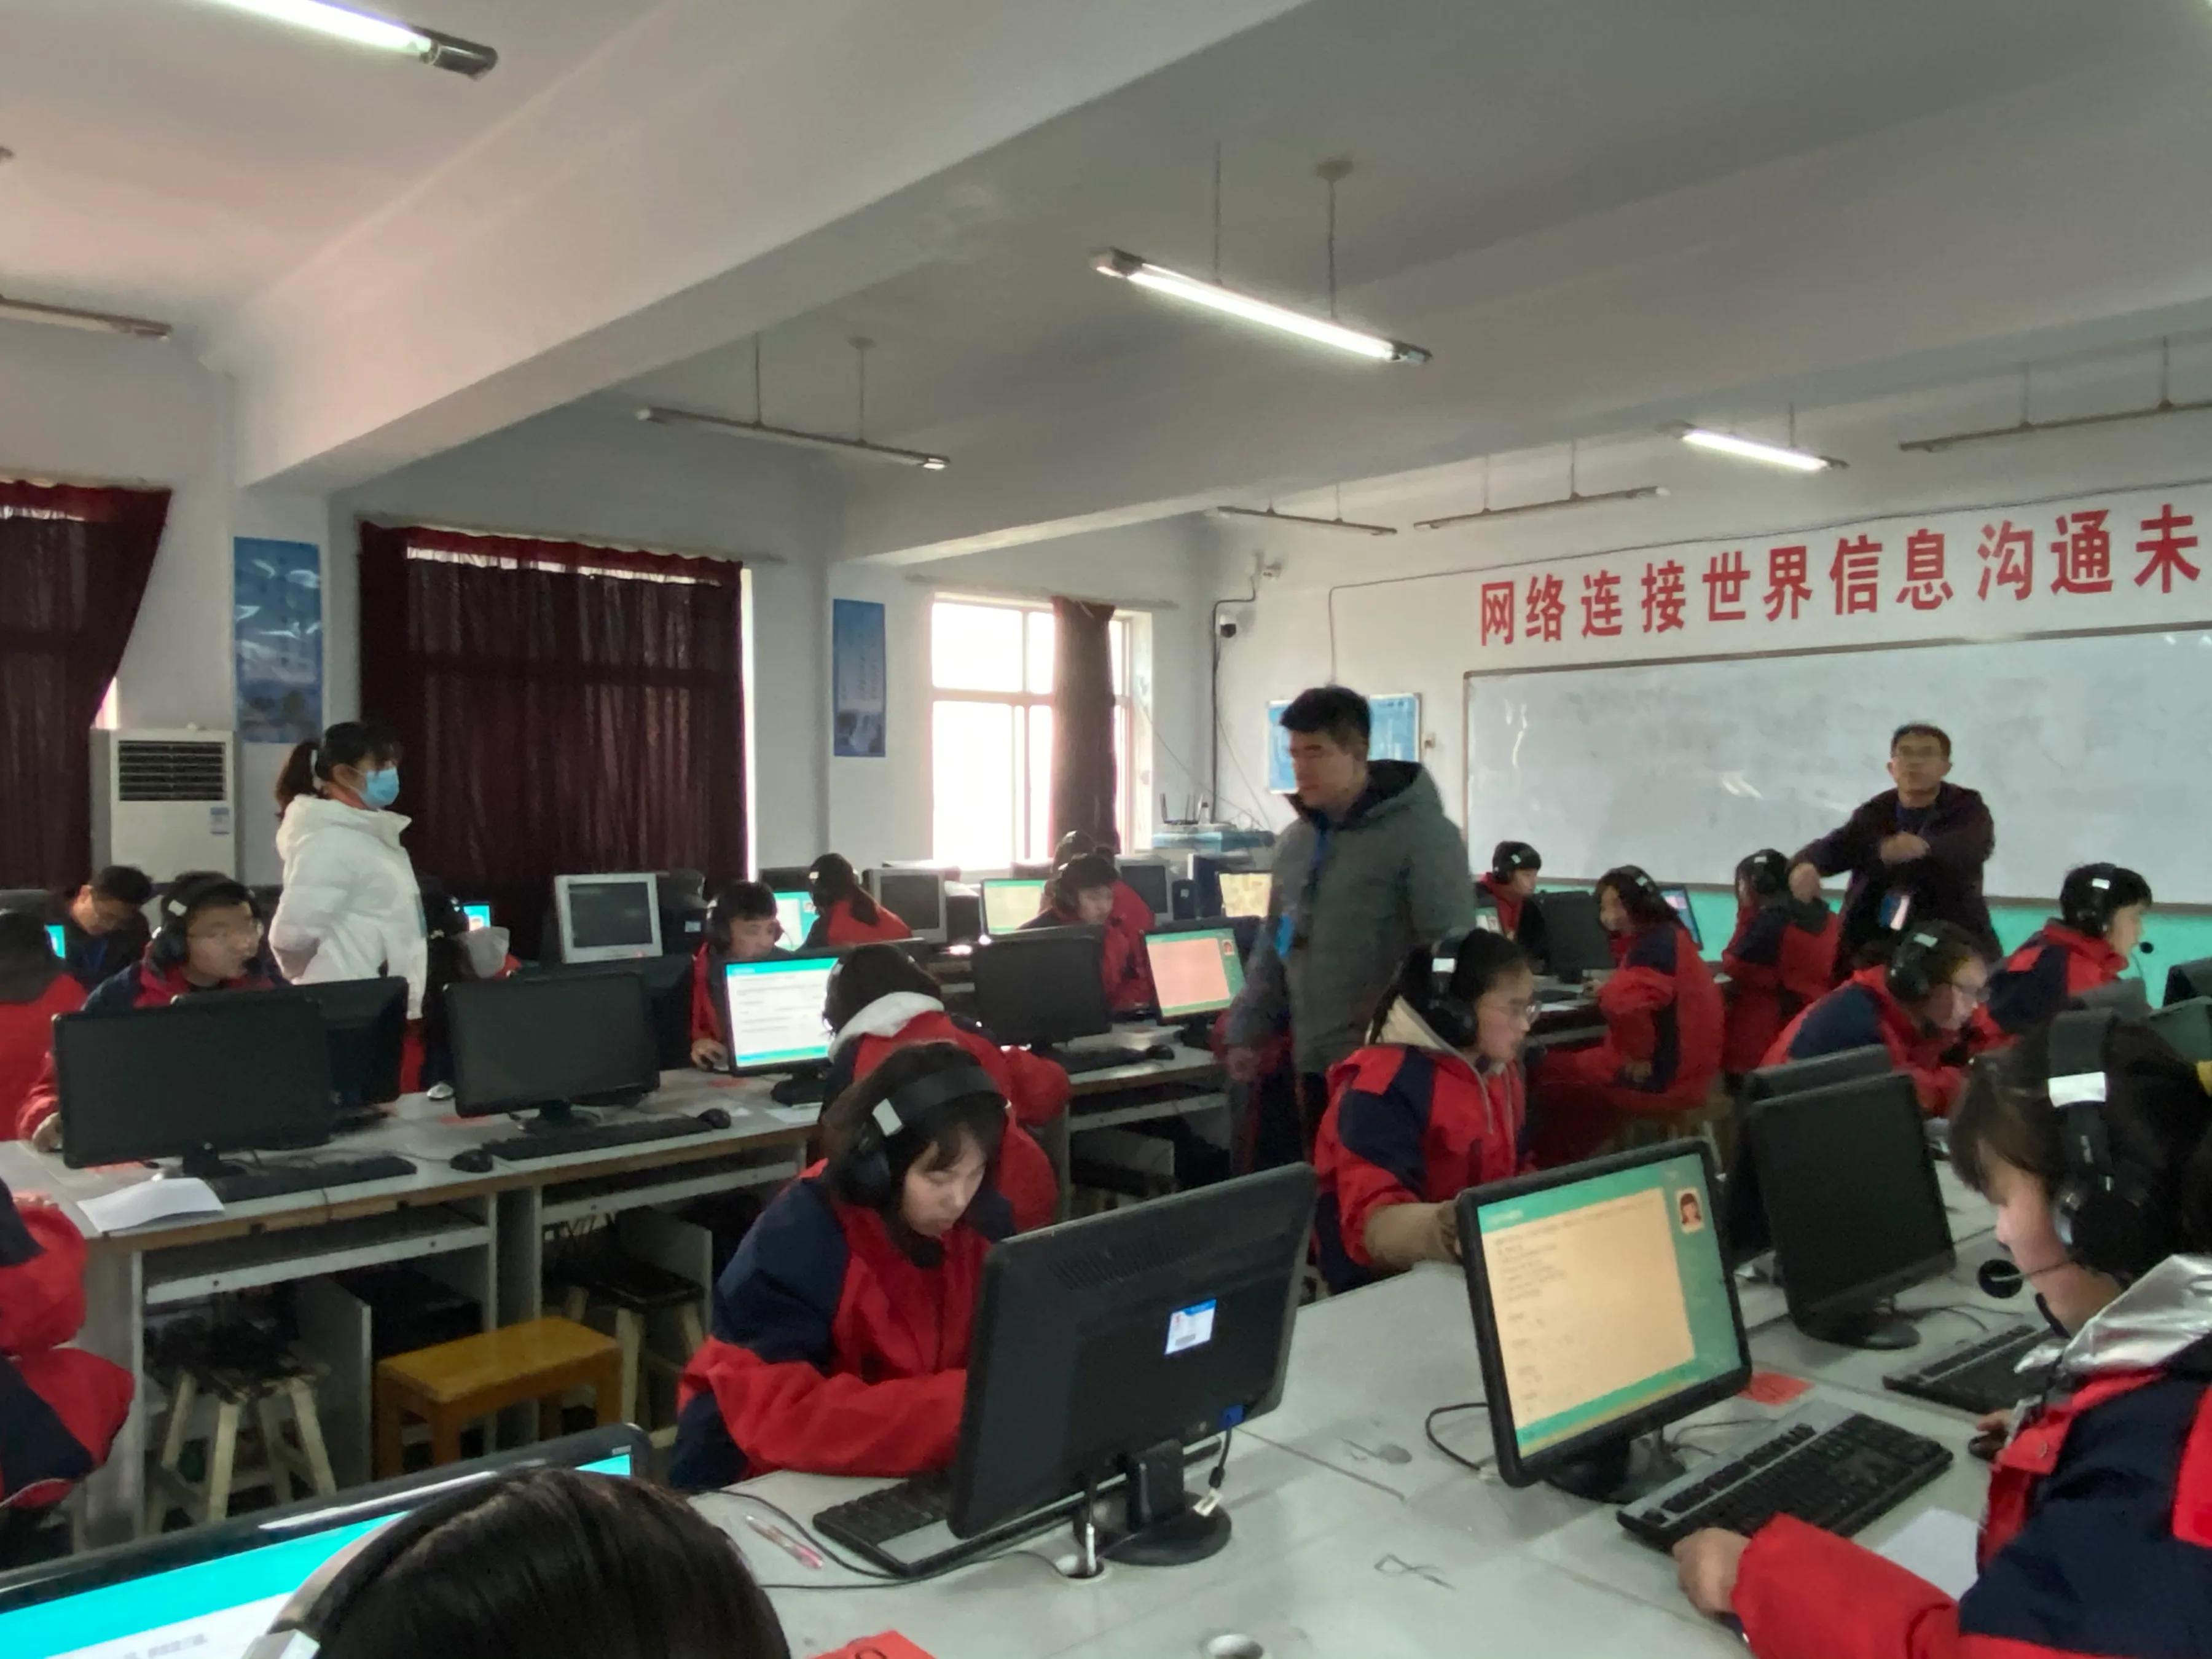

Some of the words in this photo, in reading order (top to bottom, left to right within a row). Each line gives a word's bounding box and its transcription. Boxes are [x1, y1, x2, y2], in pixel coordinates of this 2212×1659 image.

[1481, 505, 2199, 646] 网络连接世界信息沟通未
